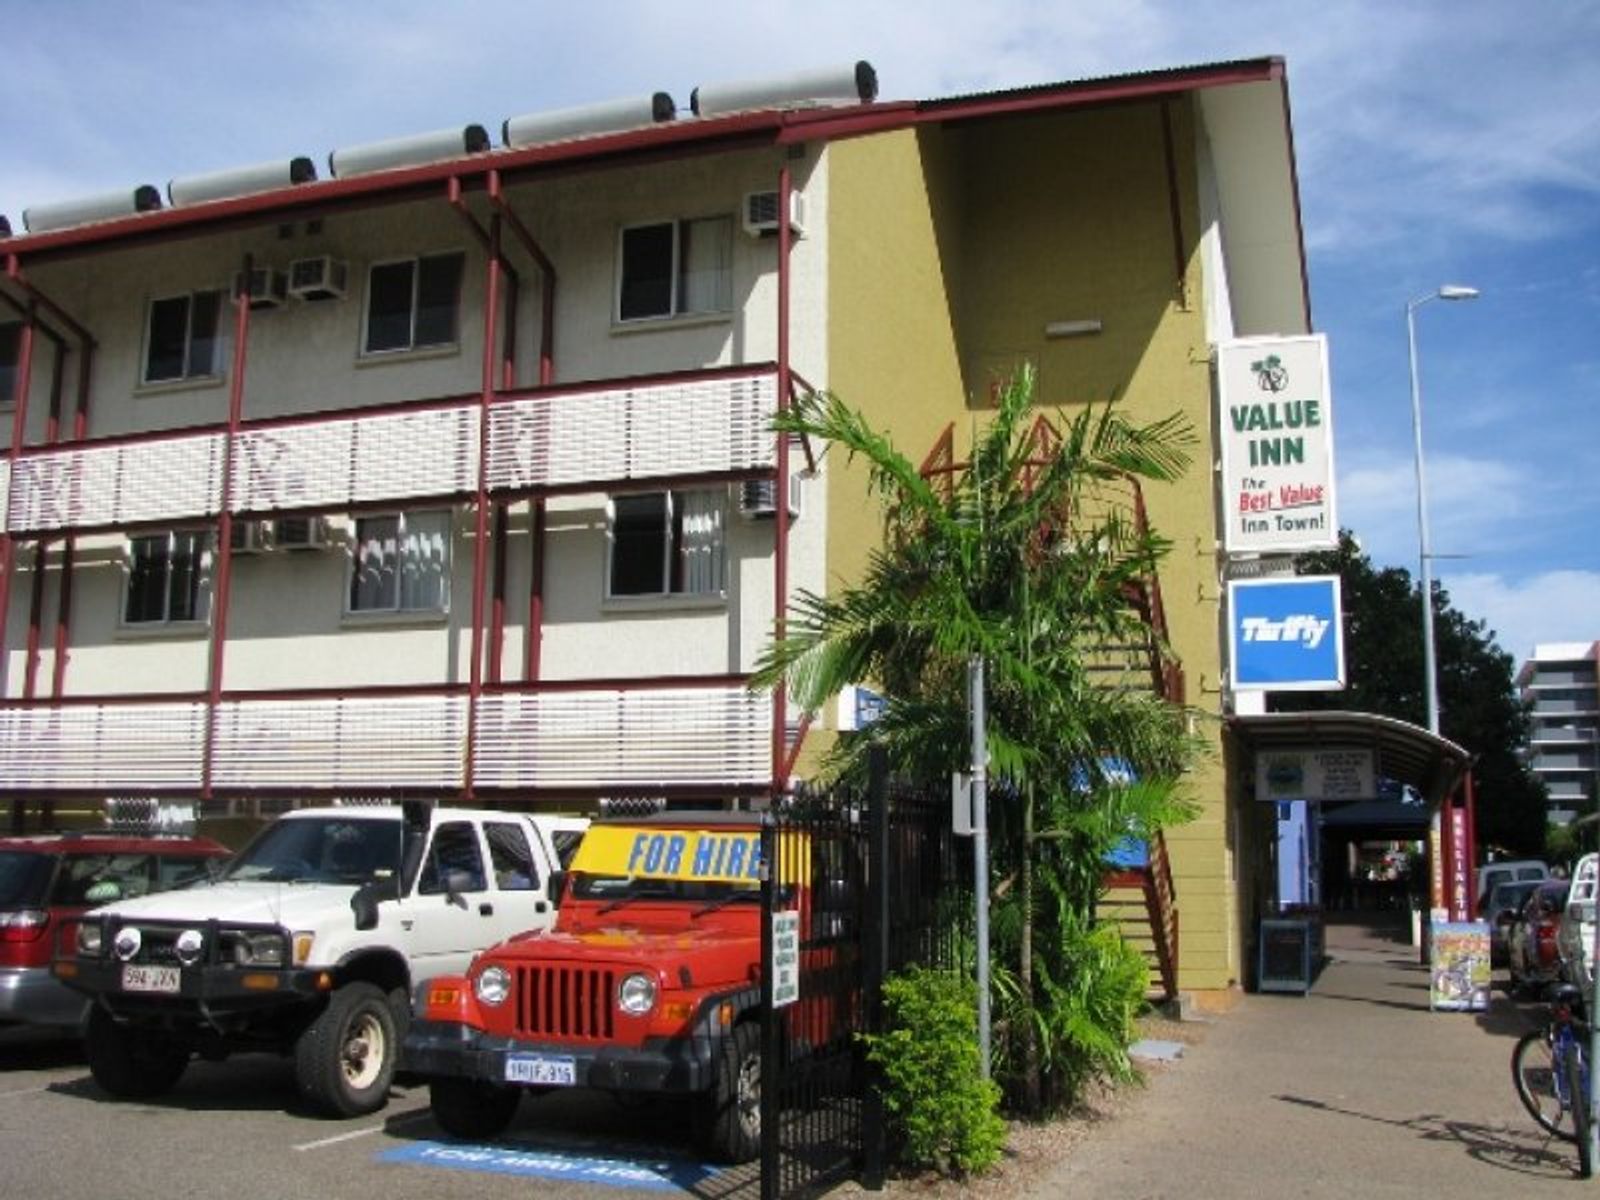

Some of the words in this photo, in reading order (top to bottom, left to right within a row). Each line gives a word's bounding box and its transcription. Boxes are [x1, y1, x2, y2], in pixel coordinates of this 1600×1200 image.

[1230, 400, 1320, 432] VALUE
[1248, 436, 1304, 467] INN
[1239, 491, 1273, 511] Best
[1280, 482, 1324, 504] Value
[1241, 478, 1266, 490] The
[1241, 517, 1269, 534] Inn
[1276, 513, 1324, 531] Town!
[627, 833, 686, 874] FOR
[691, 835, 761, 879] HIRE
